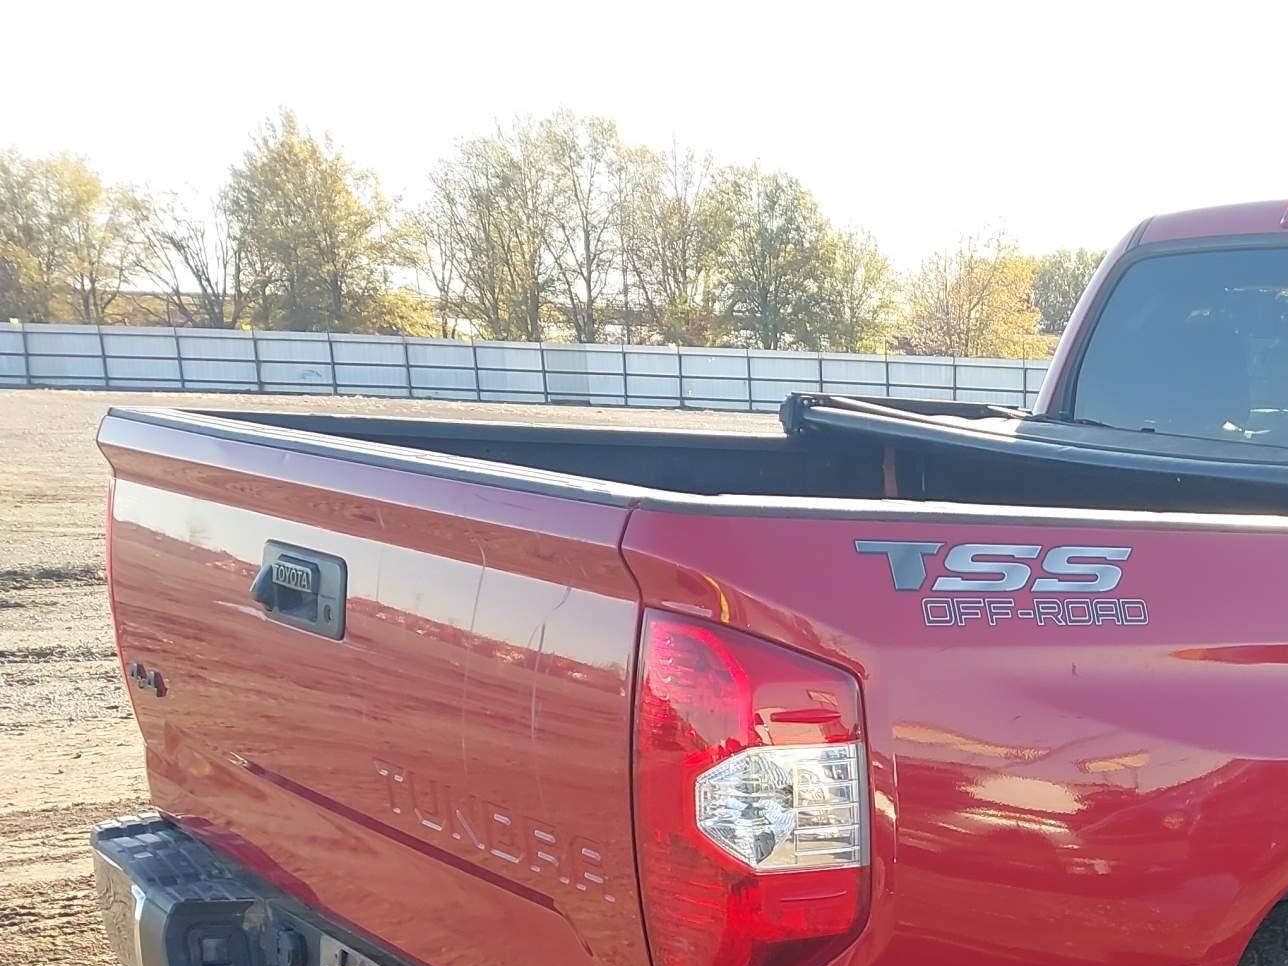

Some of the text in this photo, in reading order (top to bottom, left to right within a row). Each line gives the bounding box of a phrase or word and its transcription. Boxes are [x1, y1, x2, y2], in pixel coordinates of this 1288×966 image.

[272, 563, 309, 590] TOYOTA
[855, 539, 1133, 593] TSS
[921, 597, 1150, 627] OFF-ROAD
[373, 757, 615, 902] TUNDRA
